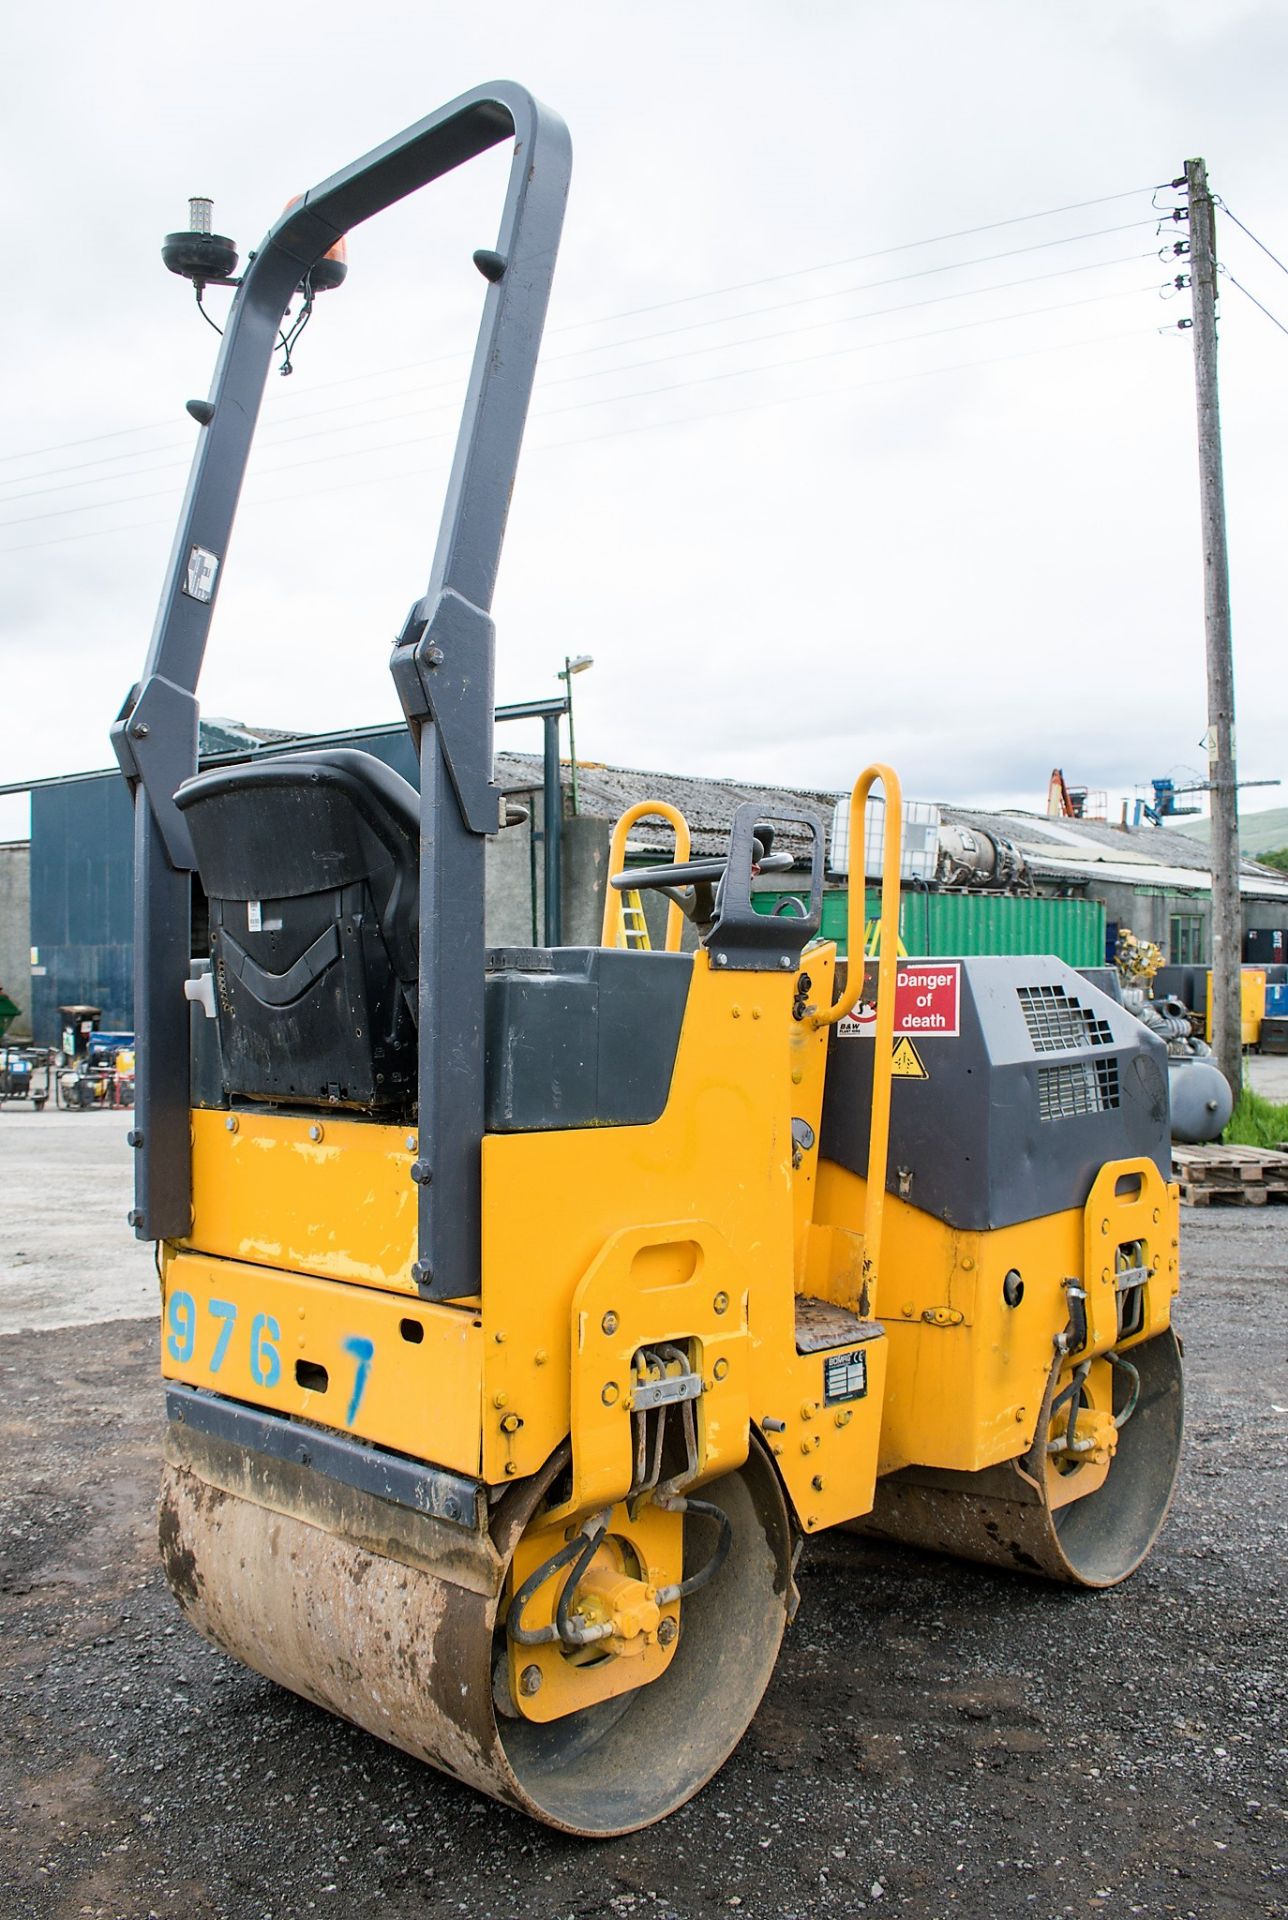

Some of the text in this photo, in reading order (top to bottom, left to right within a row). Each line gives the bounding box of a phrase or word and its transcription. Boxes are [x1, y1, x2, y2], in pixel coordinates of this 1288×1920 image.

[1273, 931, 1282, 948] SITE
[897, 973, 953, 989] Danger
[916, 992, 933, 1007] of
[902, 1013, 946, 1028] death
